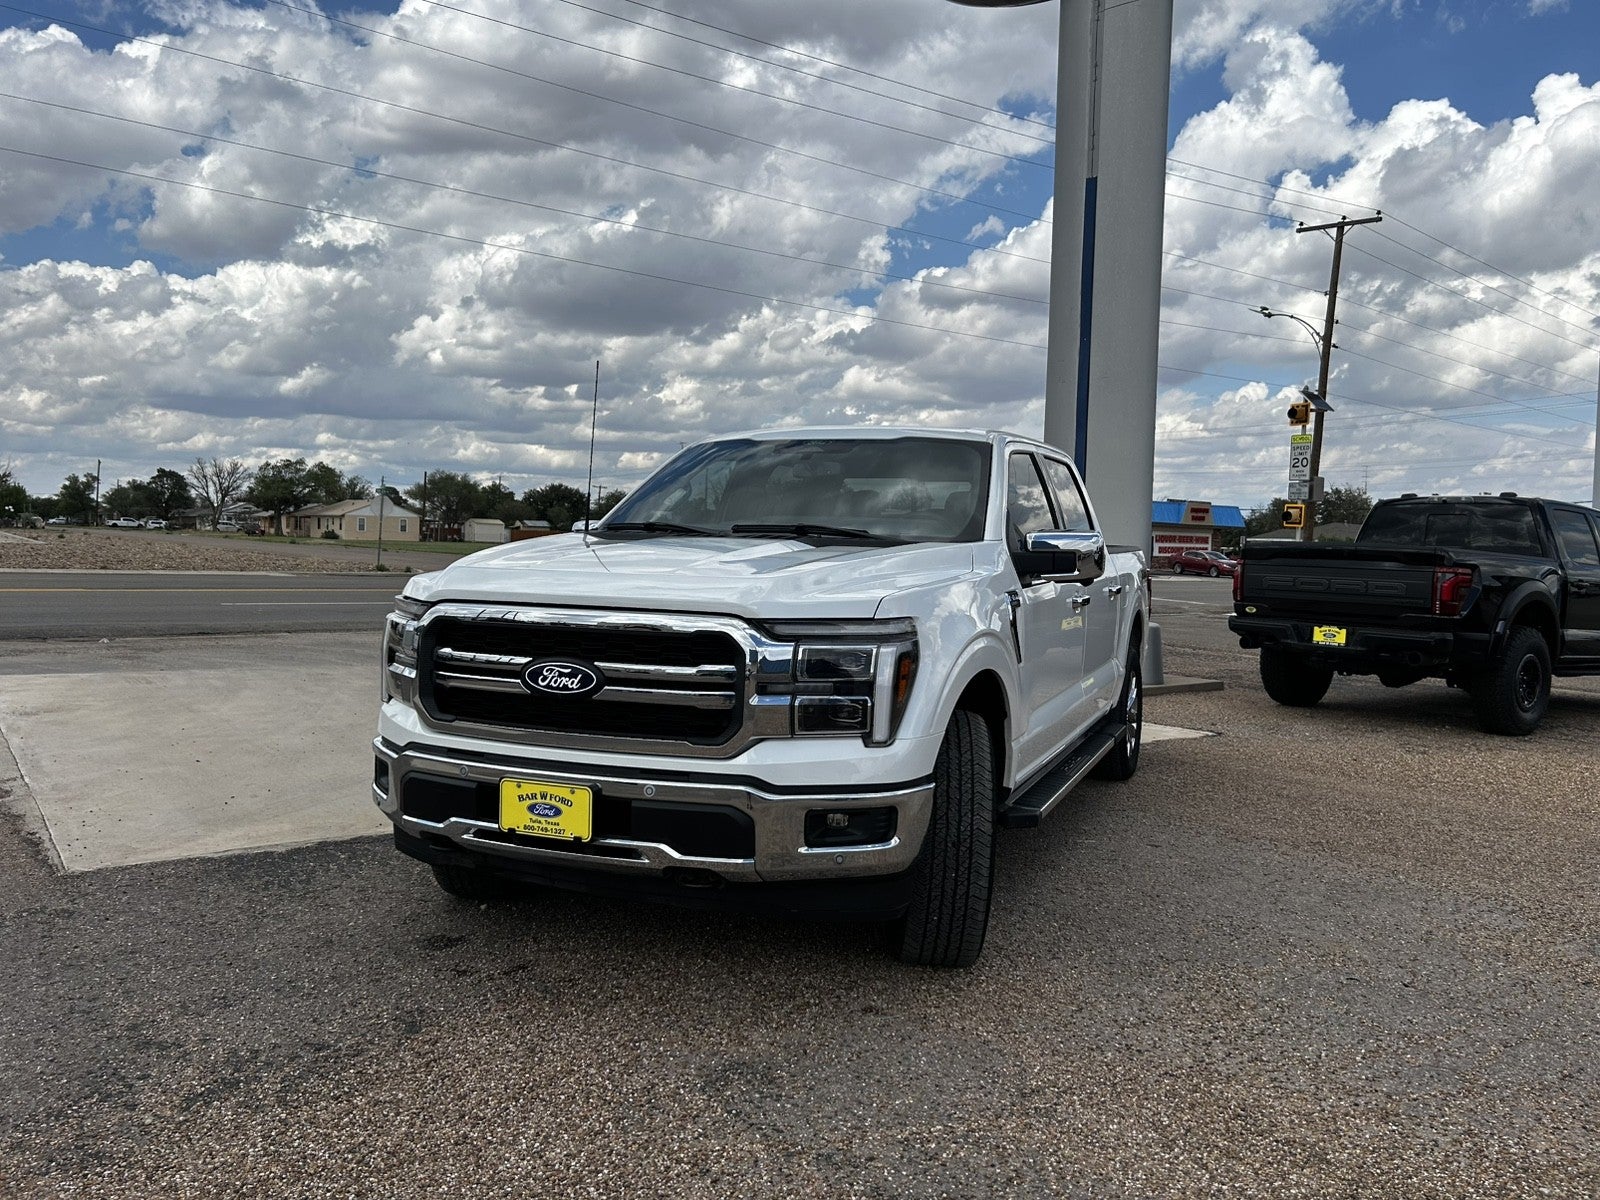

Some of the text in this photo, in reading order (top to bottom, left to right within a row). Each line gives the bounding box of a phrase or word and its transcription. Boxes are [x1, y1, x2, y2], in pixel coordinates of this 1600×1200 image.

[1292, 457, 1309, 468] 20
[1262, 576, 1408, 596] FORD
[538, 666, 582, 689] Ford
[517, 791, 573, 807] BAR W FORD
[533, 803, 555, 816] Ford
[523, 824, 566, 835] 800-749-1327
